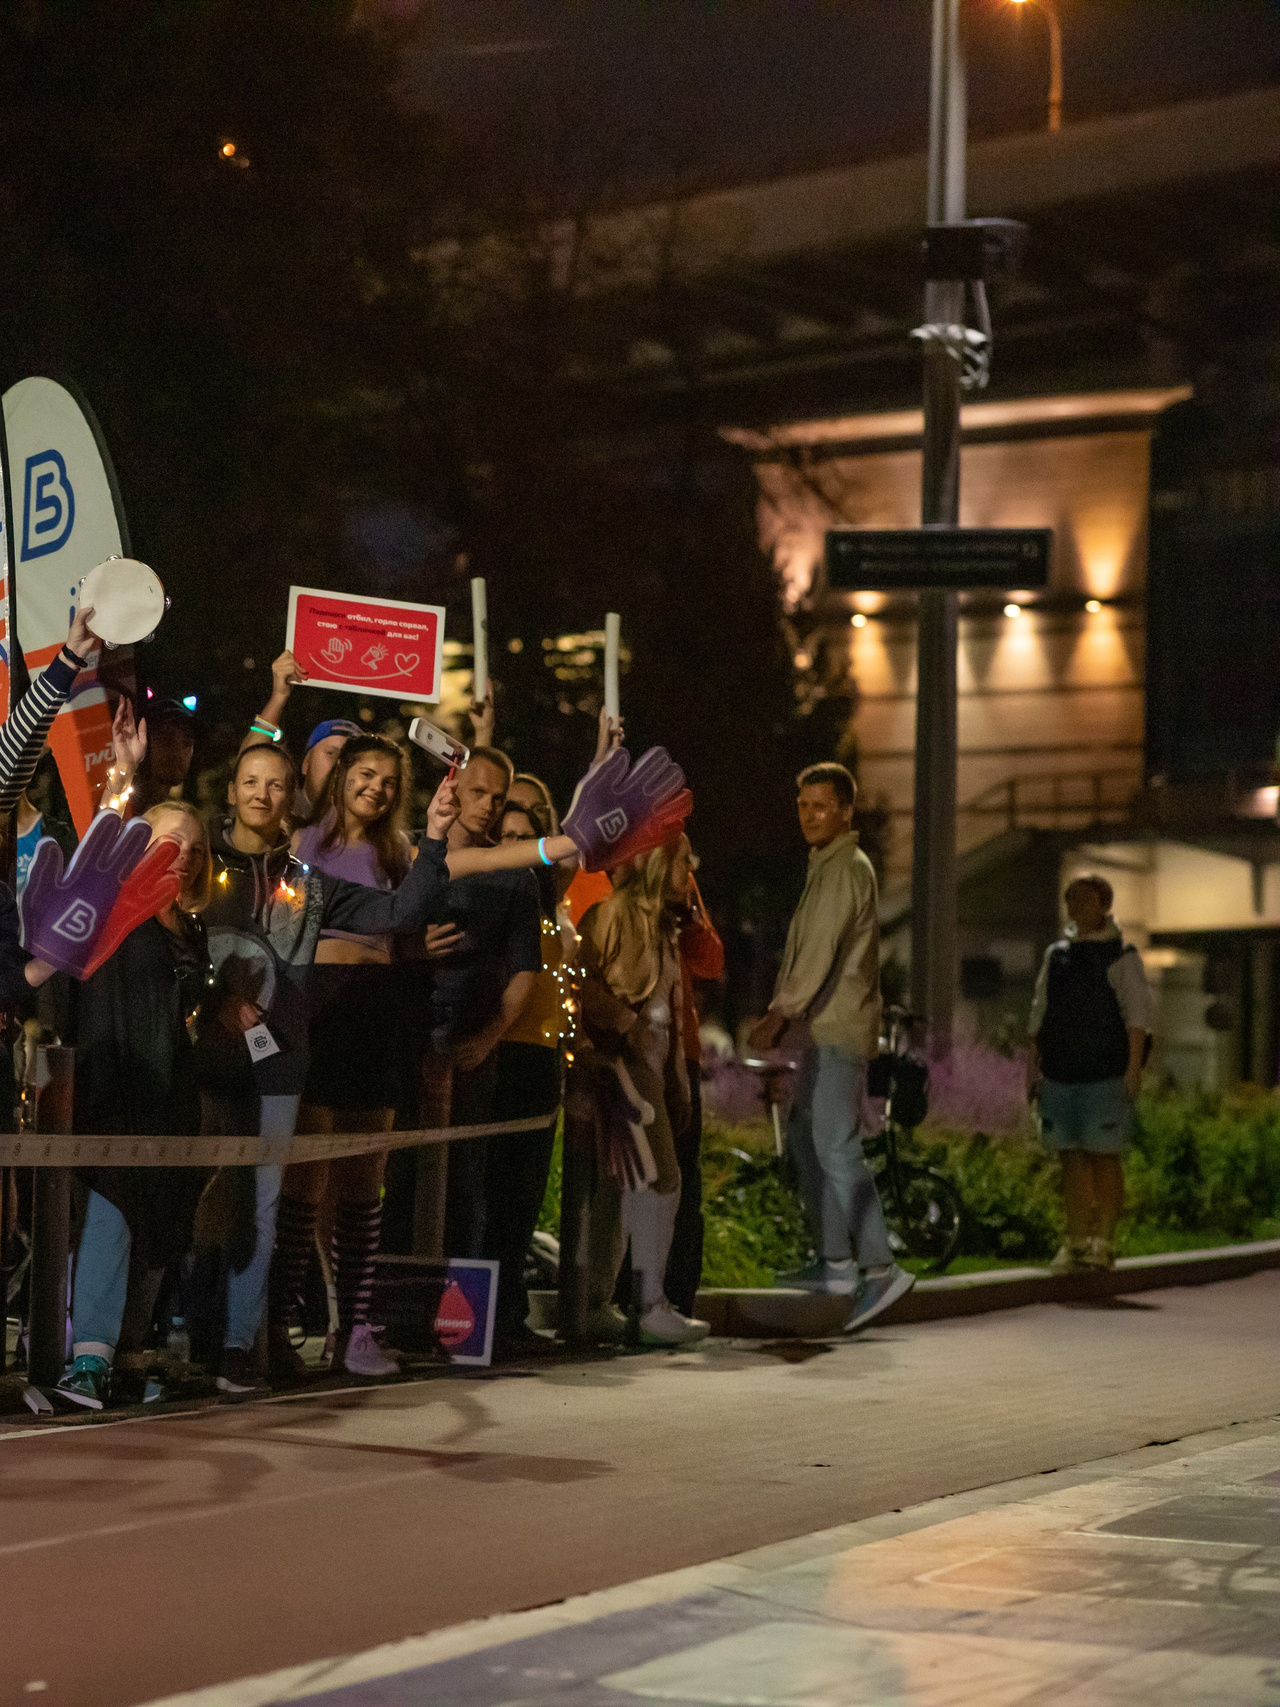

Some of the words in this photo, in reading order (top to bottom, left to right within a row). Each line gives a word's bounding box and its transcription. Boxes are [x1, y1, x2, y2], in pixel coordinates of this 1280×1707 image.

[317, 620, 338, 629] стою
[345, 624, 386, 635] табличкой
[387, 631, 402, 639] для
[403, 633, 419, 641] вас!
[347, 614, 373, 624] отбил,
[374, 618, 398, 627] горло
[399, 621, 429, 631] сорвал,
